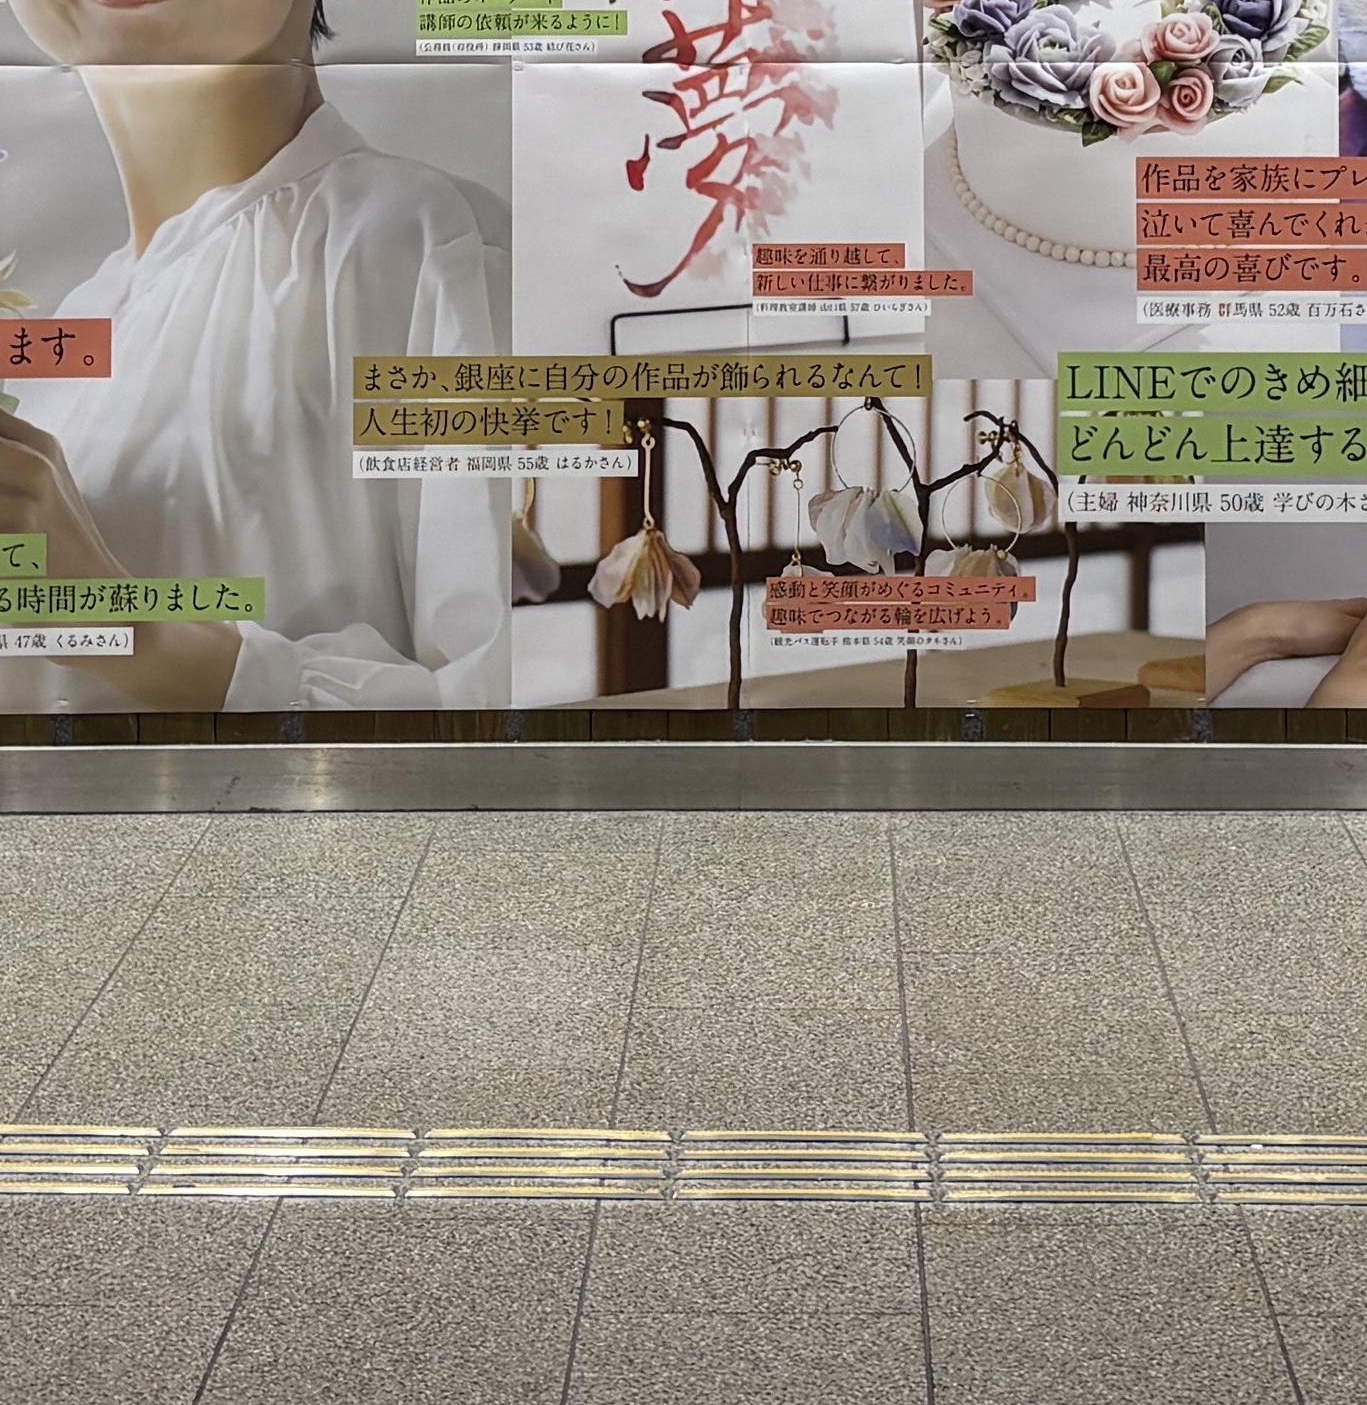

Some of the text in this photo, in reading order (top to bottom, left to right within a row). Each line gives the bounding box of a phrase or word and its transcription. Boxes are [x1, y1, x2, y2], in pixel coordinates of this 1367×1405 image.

[420, 13, 619, 31] 講師の依頼が来るように！
[756, 248, 900, 265] 趣味を通り越して、
[1143, 254, 1360, 283] 最高の喜びです。
[757, 274, 967, 291] 新しい仕事に繋がりました。
[1269, 303, 1300, 317] 52歳
[364, 363, 924, 392] まさか、銀座に自分の作品が飾られるなんて！
[361, 409, 613, 436] 人生初の快挙です！
[467, 455, 512, 472] 福岡県
[1128, 492, 1211, 513] 神奈川県
[1219, 493, 1263, 513] 50歳
[770, 580, 1028, 598] 感動と笑顔がめぐるコミュニティ。
[771, 607, 1001, 625] 趣味でつながる輪を広げよう。
